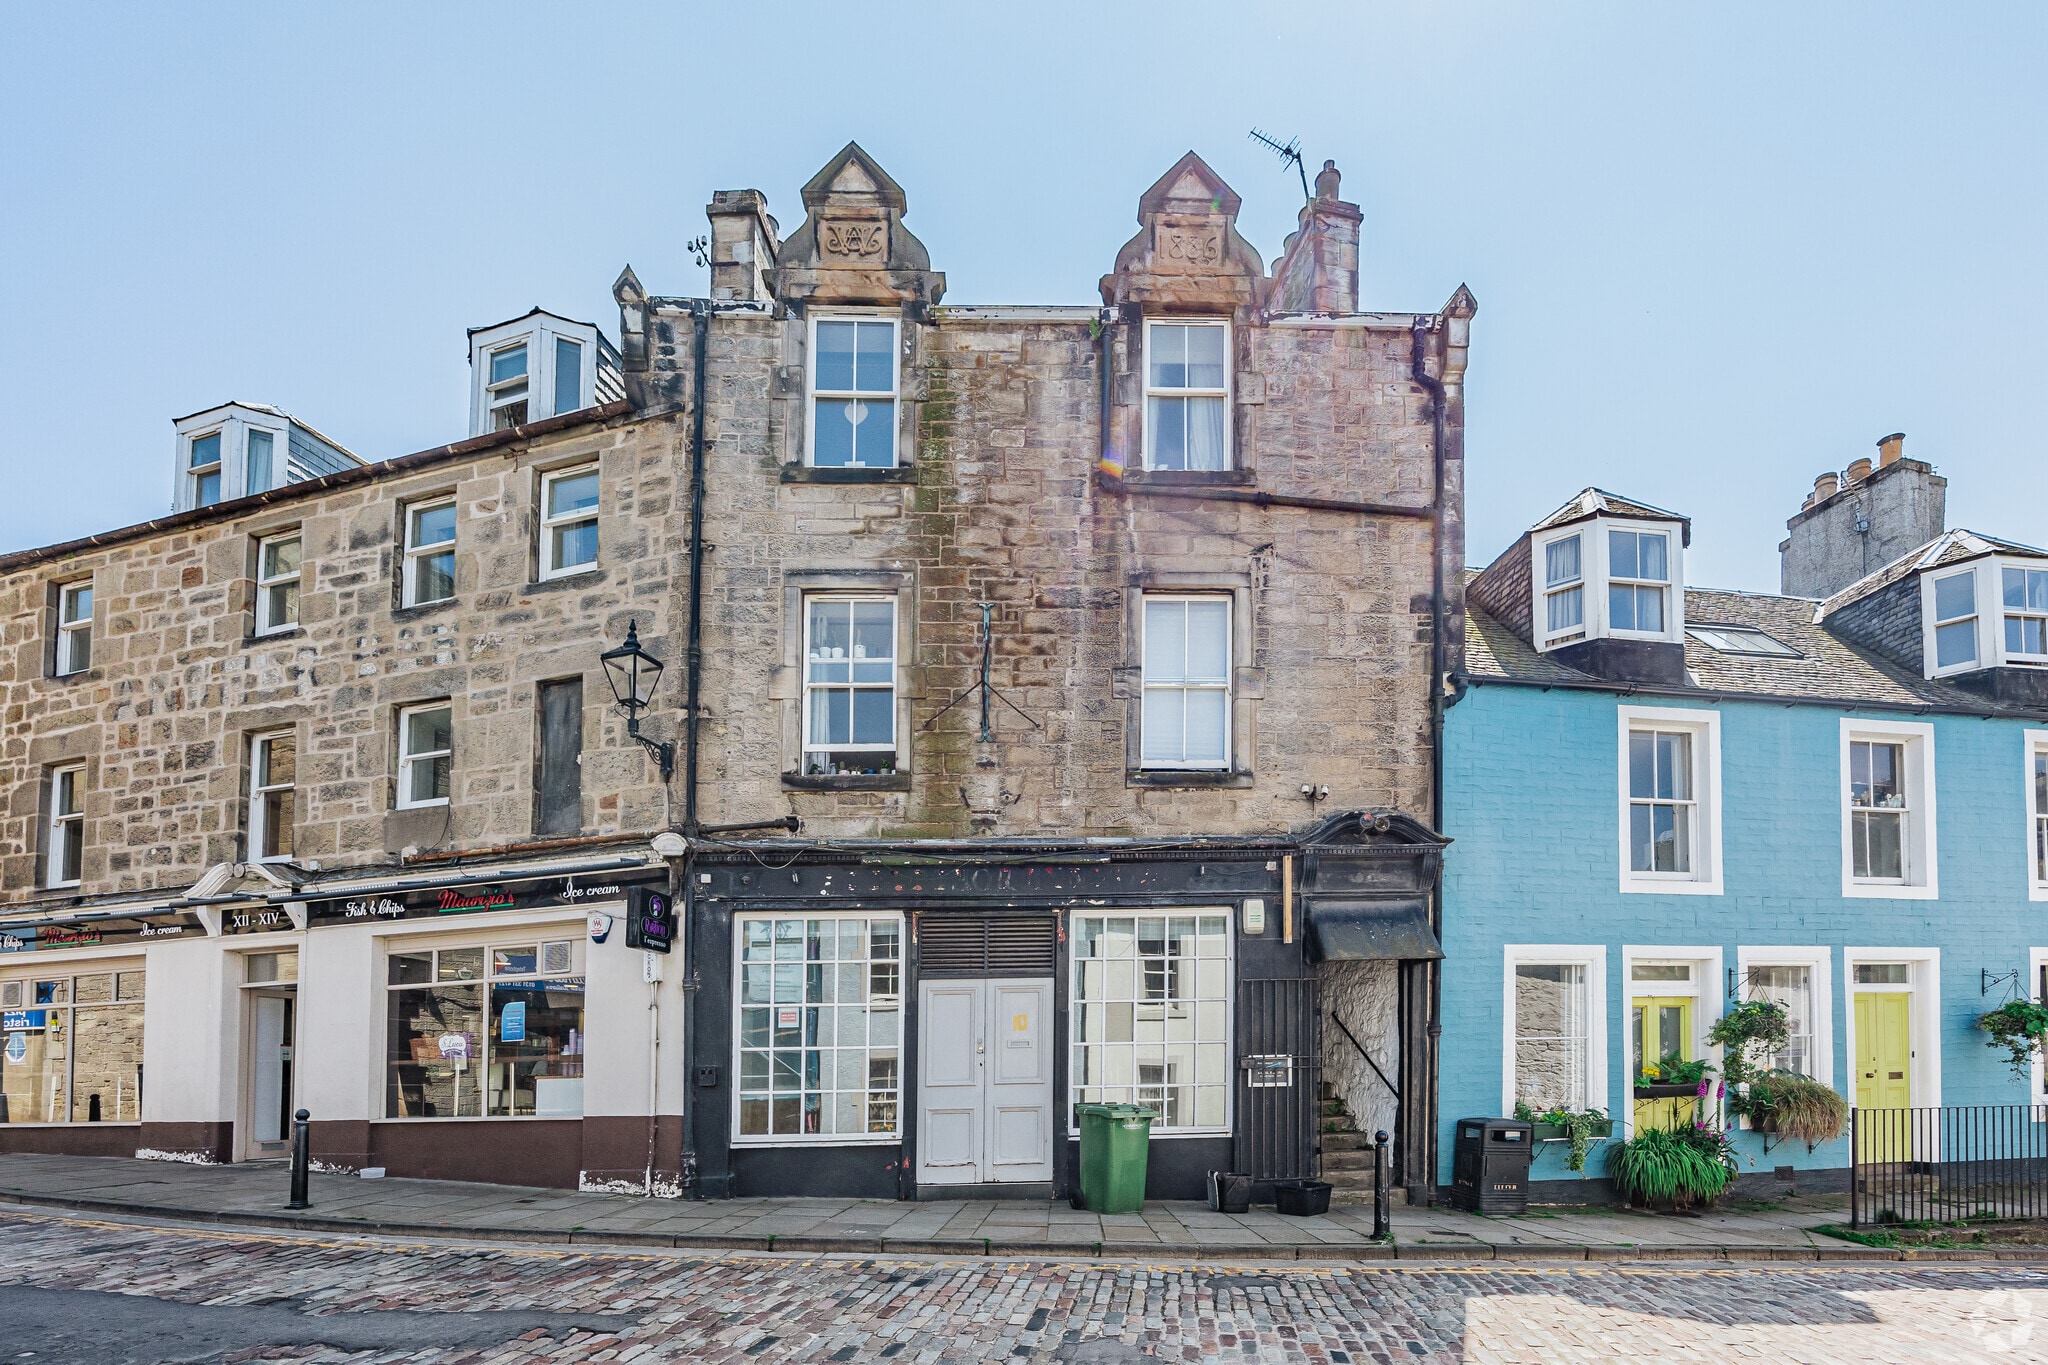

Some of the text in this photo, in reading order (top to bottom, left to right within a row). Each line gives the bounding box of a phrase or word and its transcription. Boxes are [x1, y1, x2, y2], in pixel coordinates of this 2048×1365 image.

[1159, 234, 1218, 260] 1886
[563, 881, 621, 898] Ice cream
[345, 902, 367, 918] Fish
[377, 899, 406, 917] Chips
[438, 889, 515, 912] Maurizio's
[233, 914, 249, 927] XII
[258, 912, 279, 926] XIV
[139, 923, 183, 936] Ice cream
[1012, 1013, 1028, 1032] 10
